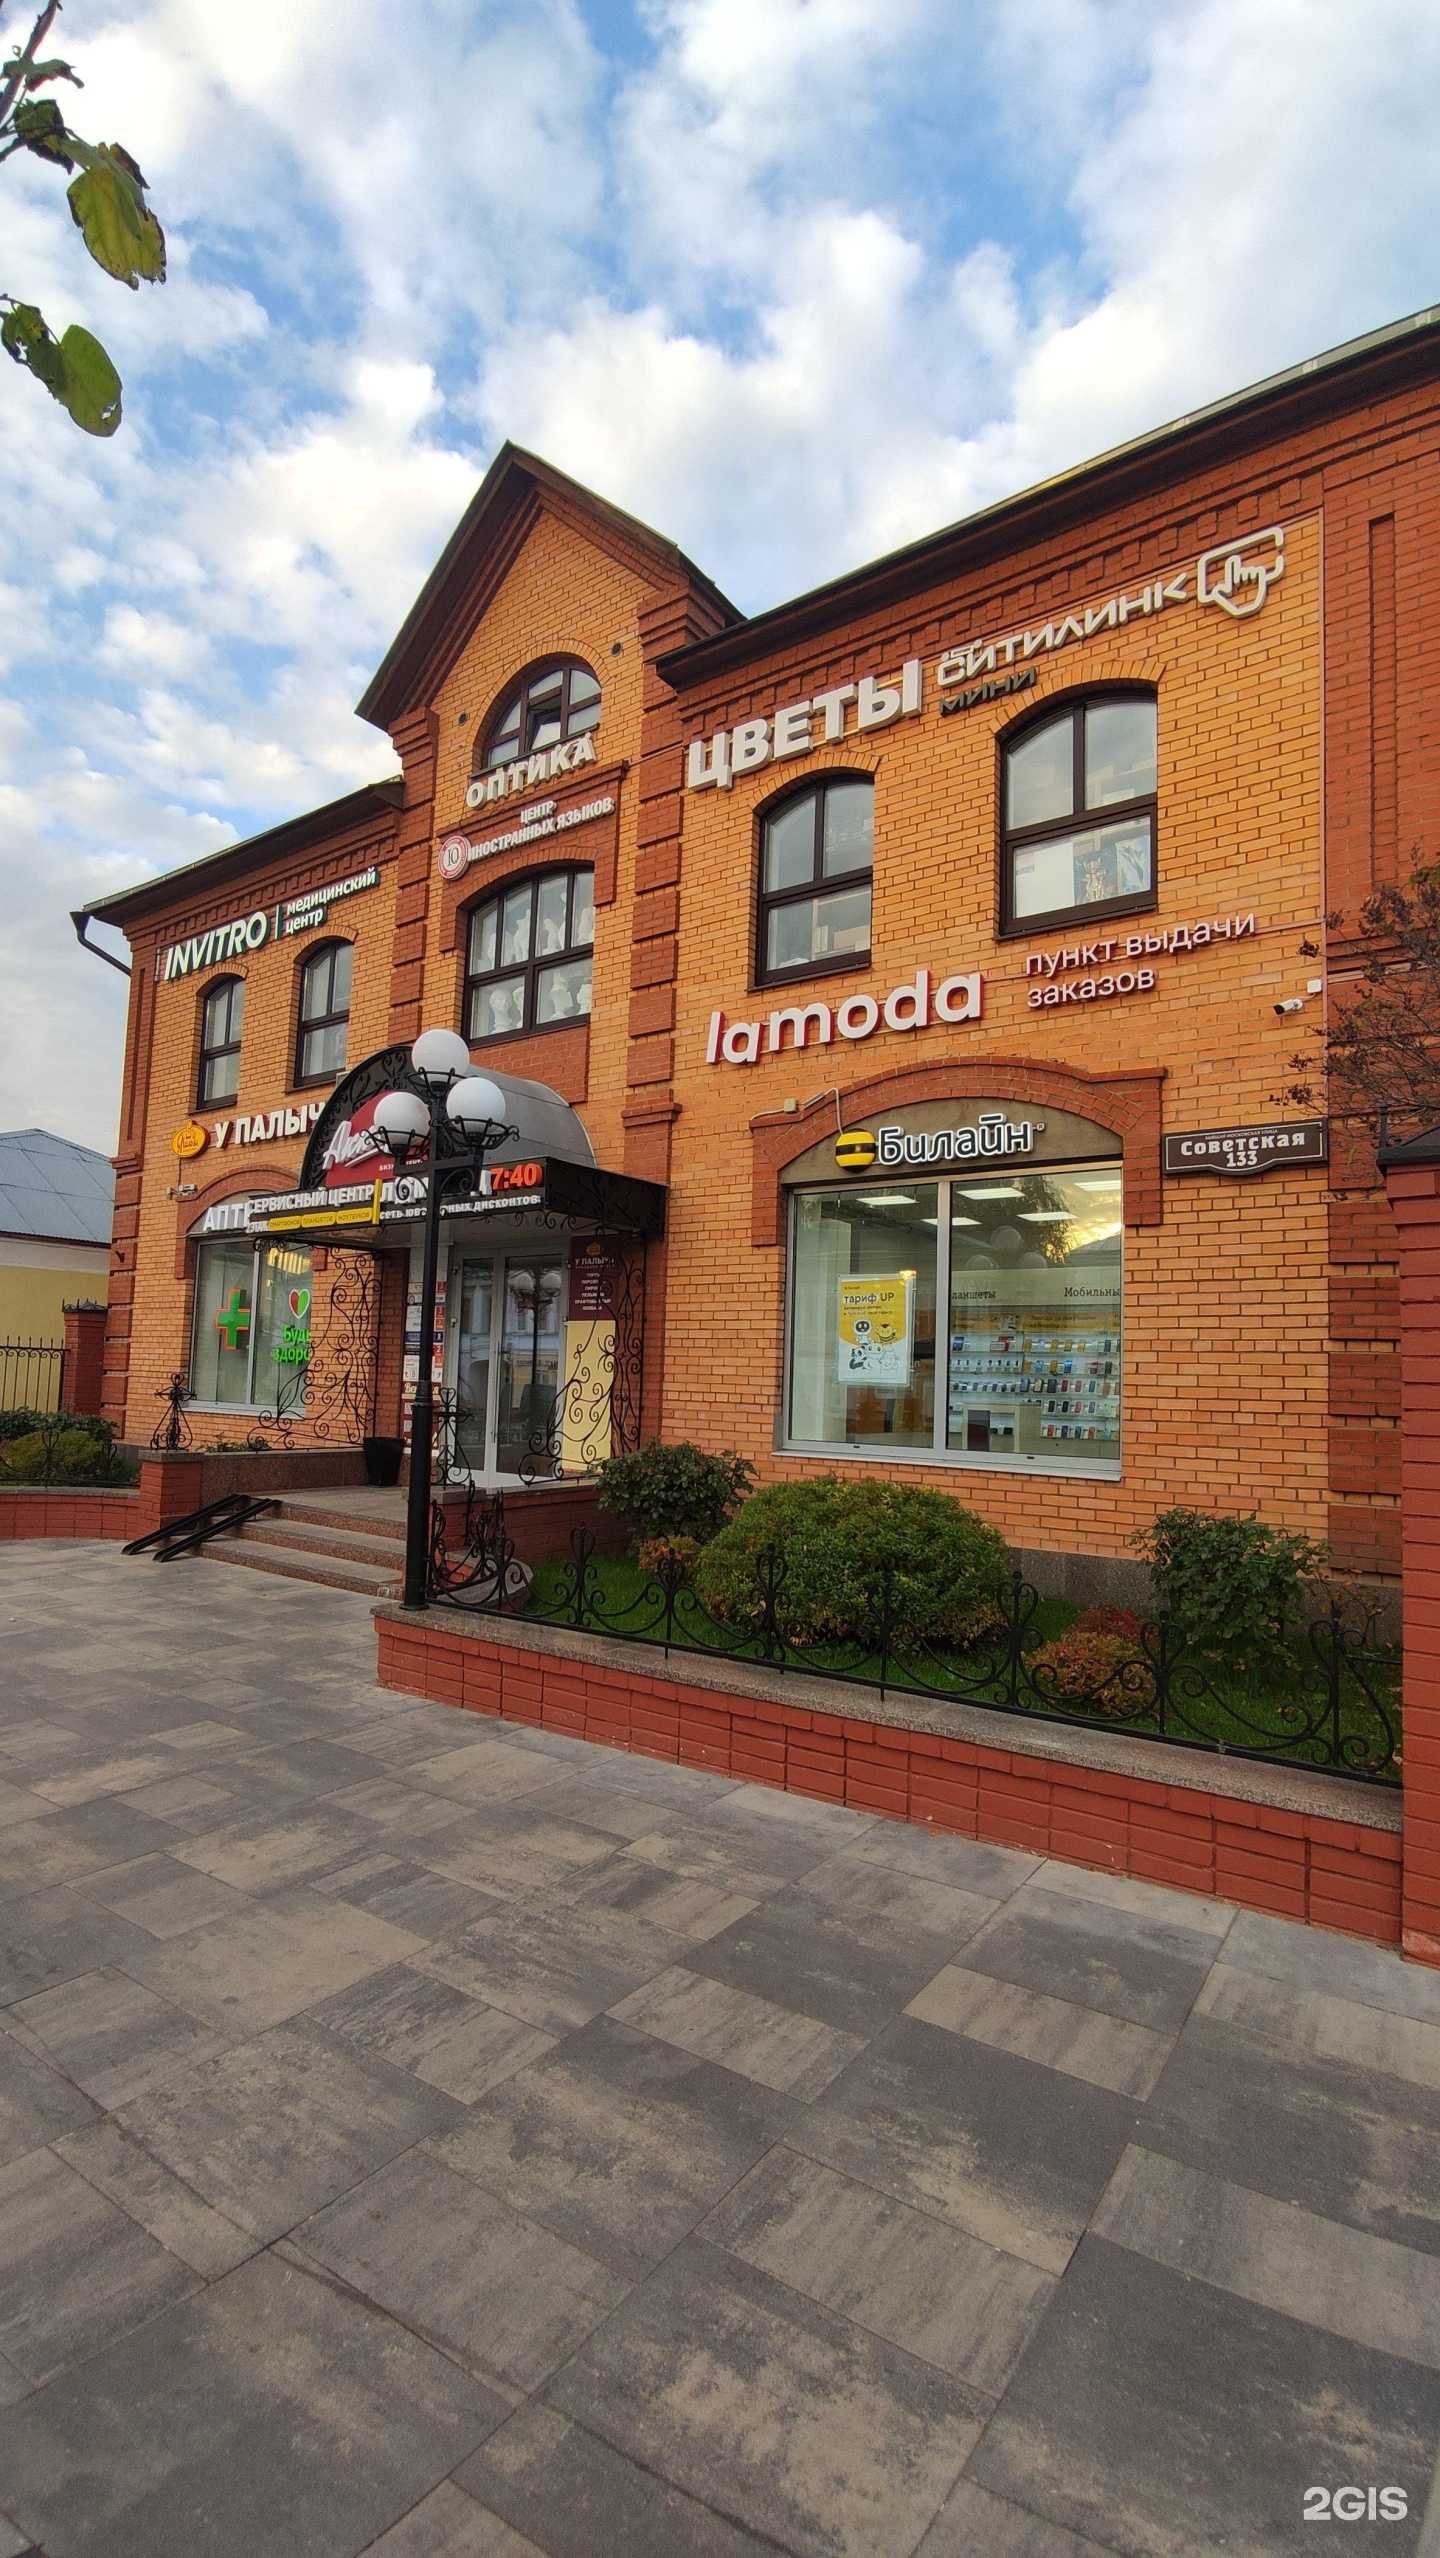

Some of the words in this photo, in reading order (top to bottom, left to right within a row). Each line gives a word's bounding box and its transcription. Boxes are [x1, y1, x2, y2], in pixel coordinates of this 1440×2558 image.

[940, 666, 1037, 716] МИНИ
[687, 657, 924, 791] ЦВЕТЫ
[466, 732, 598, 810] ОПТИКА
[467, 818, 557, 863] ИНОСТРАННЫХ
[556, 796, 616, 831] ЯЗЫКОВ
[520, 800, 558, 824] ЦЕНТР
[286, 866, 377, 917] медицинский
[285, 908, 324, 934] центр
[164, 911, 269, 981] INVITRO
[1025, 939, 1119, 979] пункт
[1126, 912, 1256, 957] выдачи
[1027, 968, 1156, 1010] заказов
[705, 969, 986, 1067] lamoda
[214, 1121, 231, 1148] У
[1180, 1132, 1305, 1156] Советская
[490, 1162, 543, 1192] 7:40
[1226, 1150, 1258, 1168] 133
[248, 1187, 329, 1214] СЕРВИСНЫЙ
[328, 1184, 374, 1207] ЦЕНТР
[844, 1292, 877, 1305] тариф
[880, 1291, 895, 1302] UP
